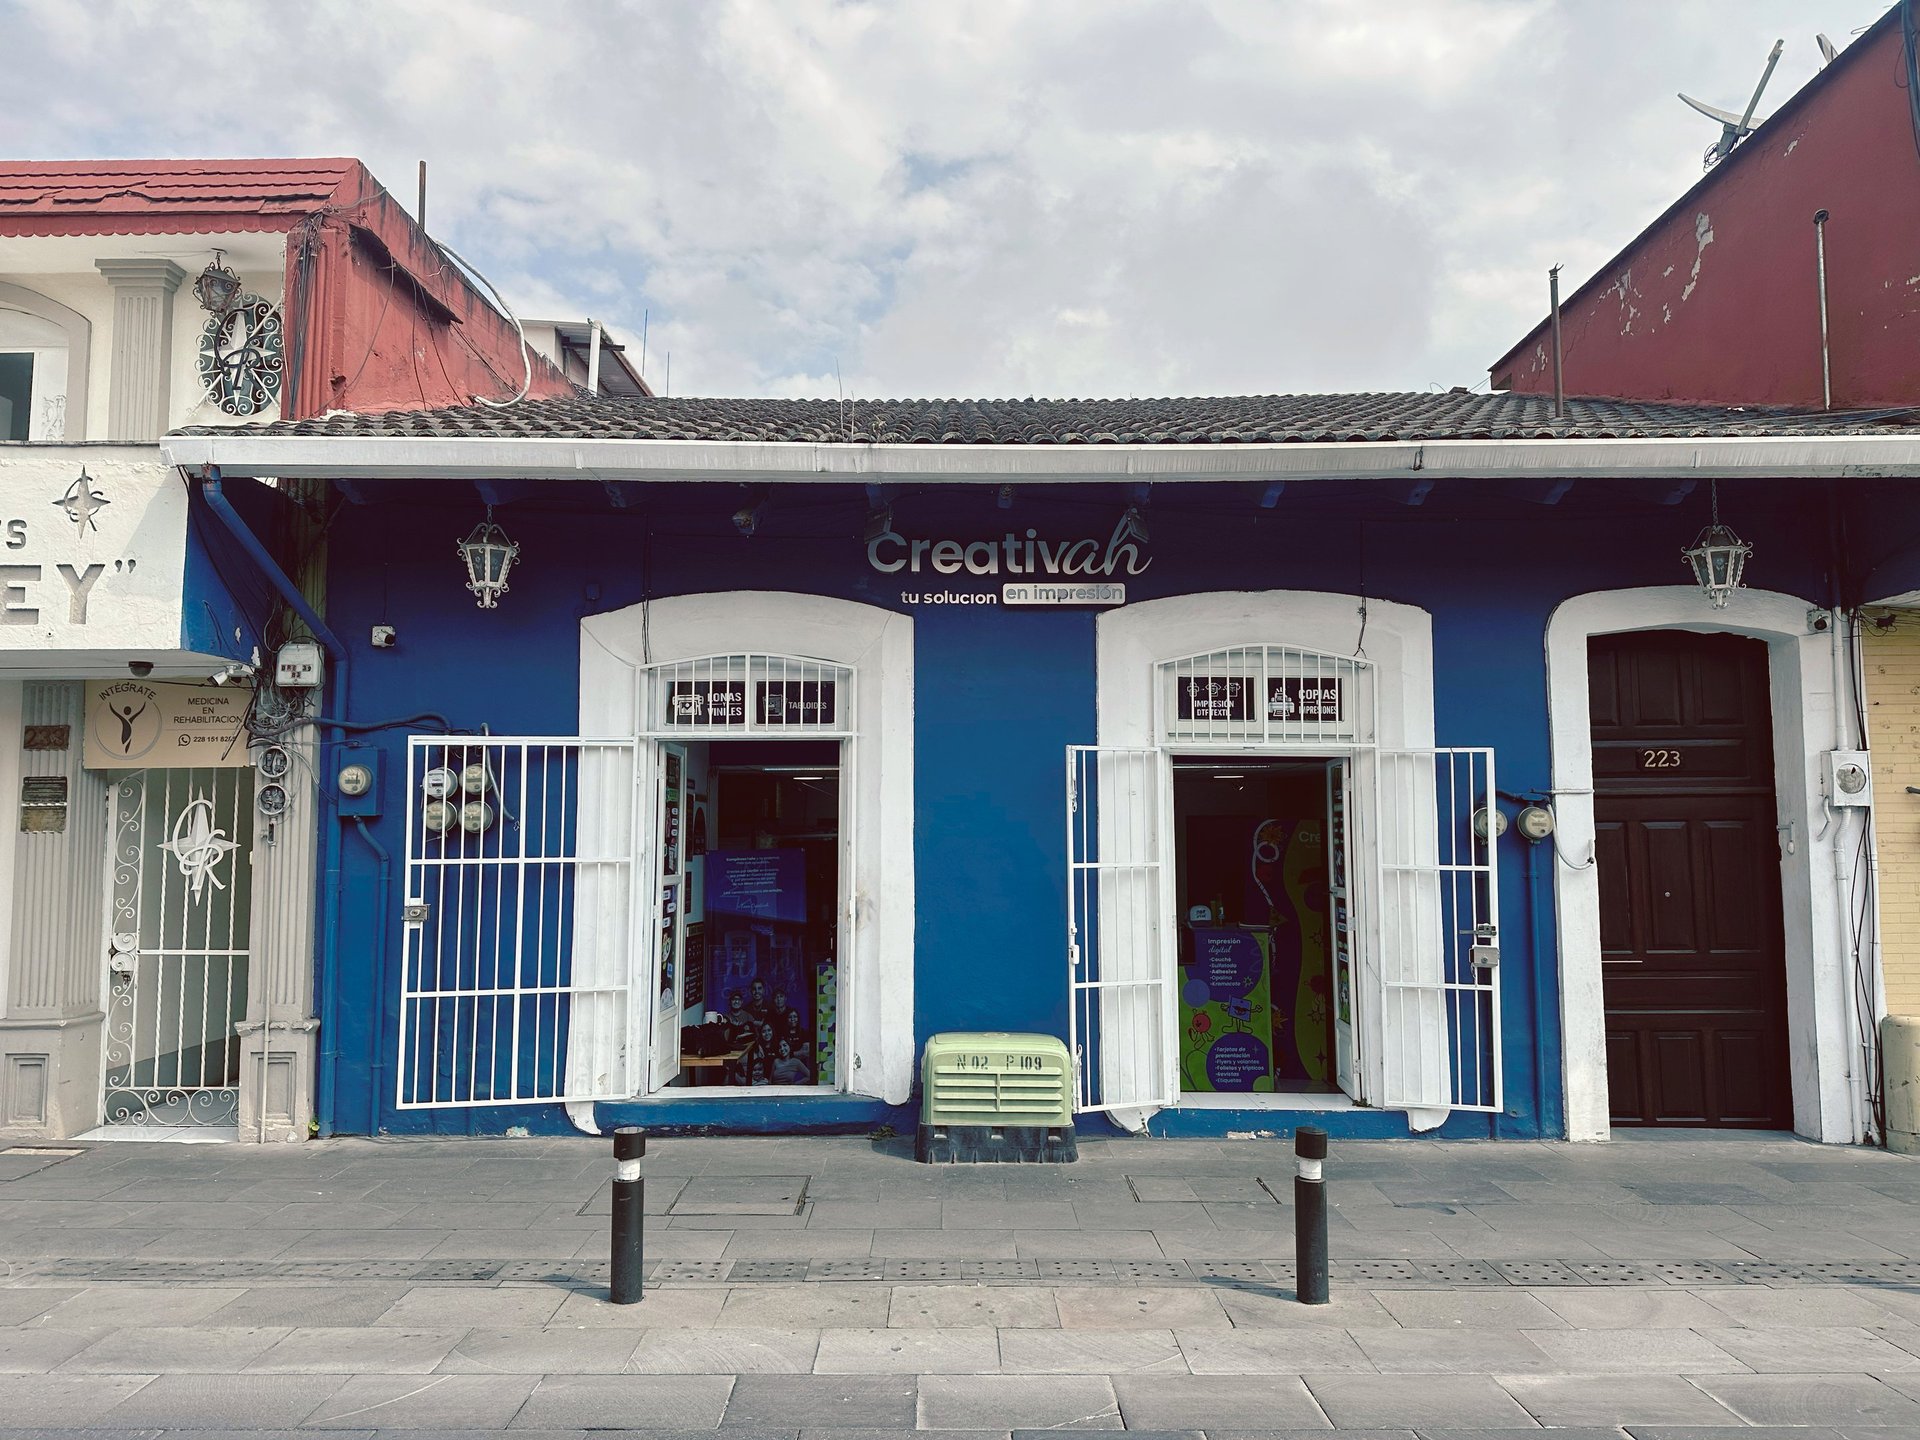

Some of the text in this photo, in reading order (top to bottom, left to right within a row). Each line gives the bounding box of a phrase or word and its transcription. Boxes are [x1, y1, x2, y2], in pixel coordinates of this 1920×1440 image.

[867, 510, 1152, 576] Creativah
[901, 591, 919, 604] tu
[1005, 588, 1028, 600] en
[1033, 584, 1123, 603] impresión
[99, 682, 157, 701] INTÉGRATE
[707, 692, 742, 702] LONAS
[187, 697, 230, 706] MEDICINA
[1196, 708, 1209, 717] DTF
[1643, 750, 1681, 768] 223
[1207, 937, 1241, 946] Impresión
[972, 1055, 989, 1070] 02
[1006, 1055, 1014, 1071] P
[1021, 1055, 1043, 1071] 109
